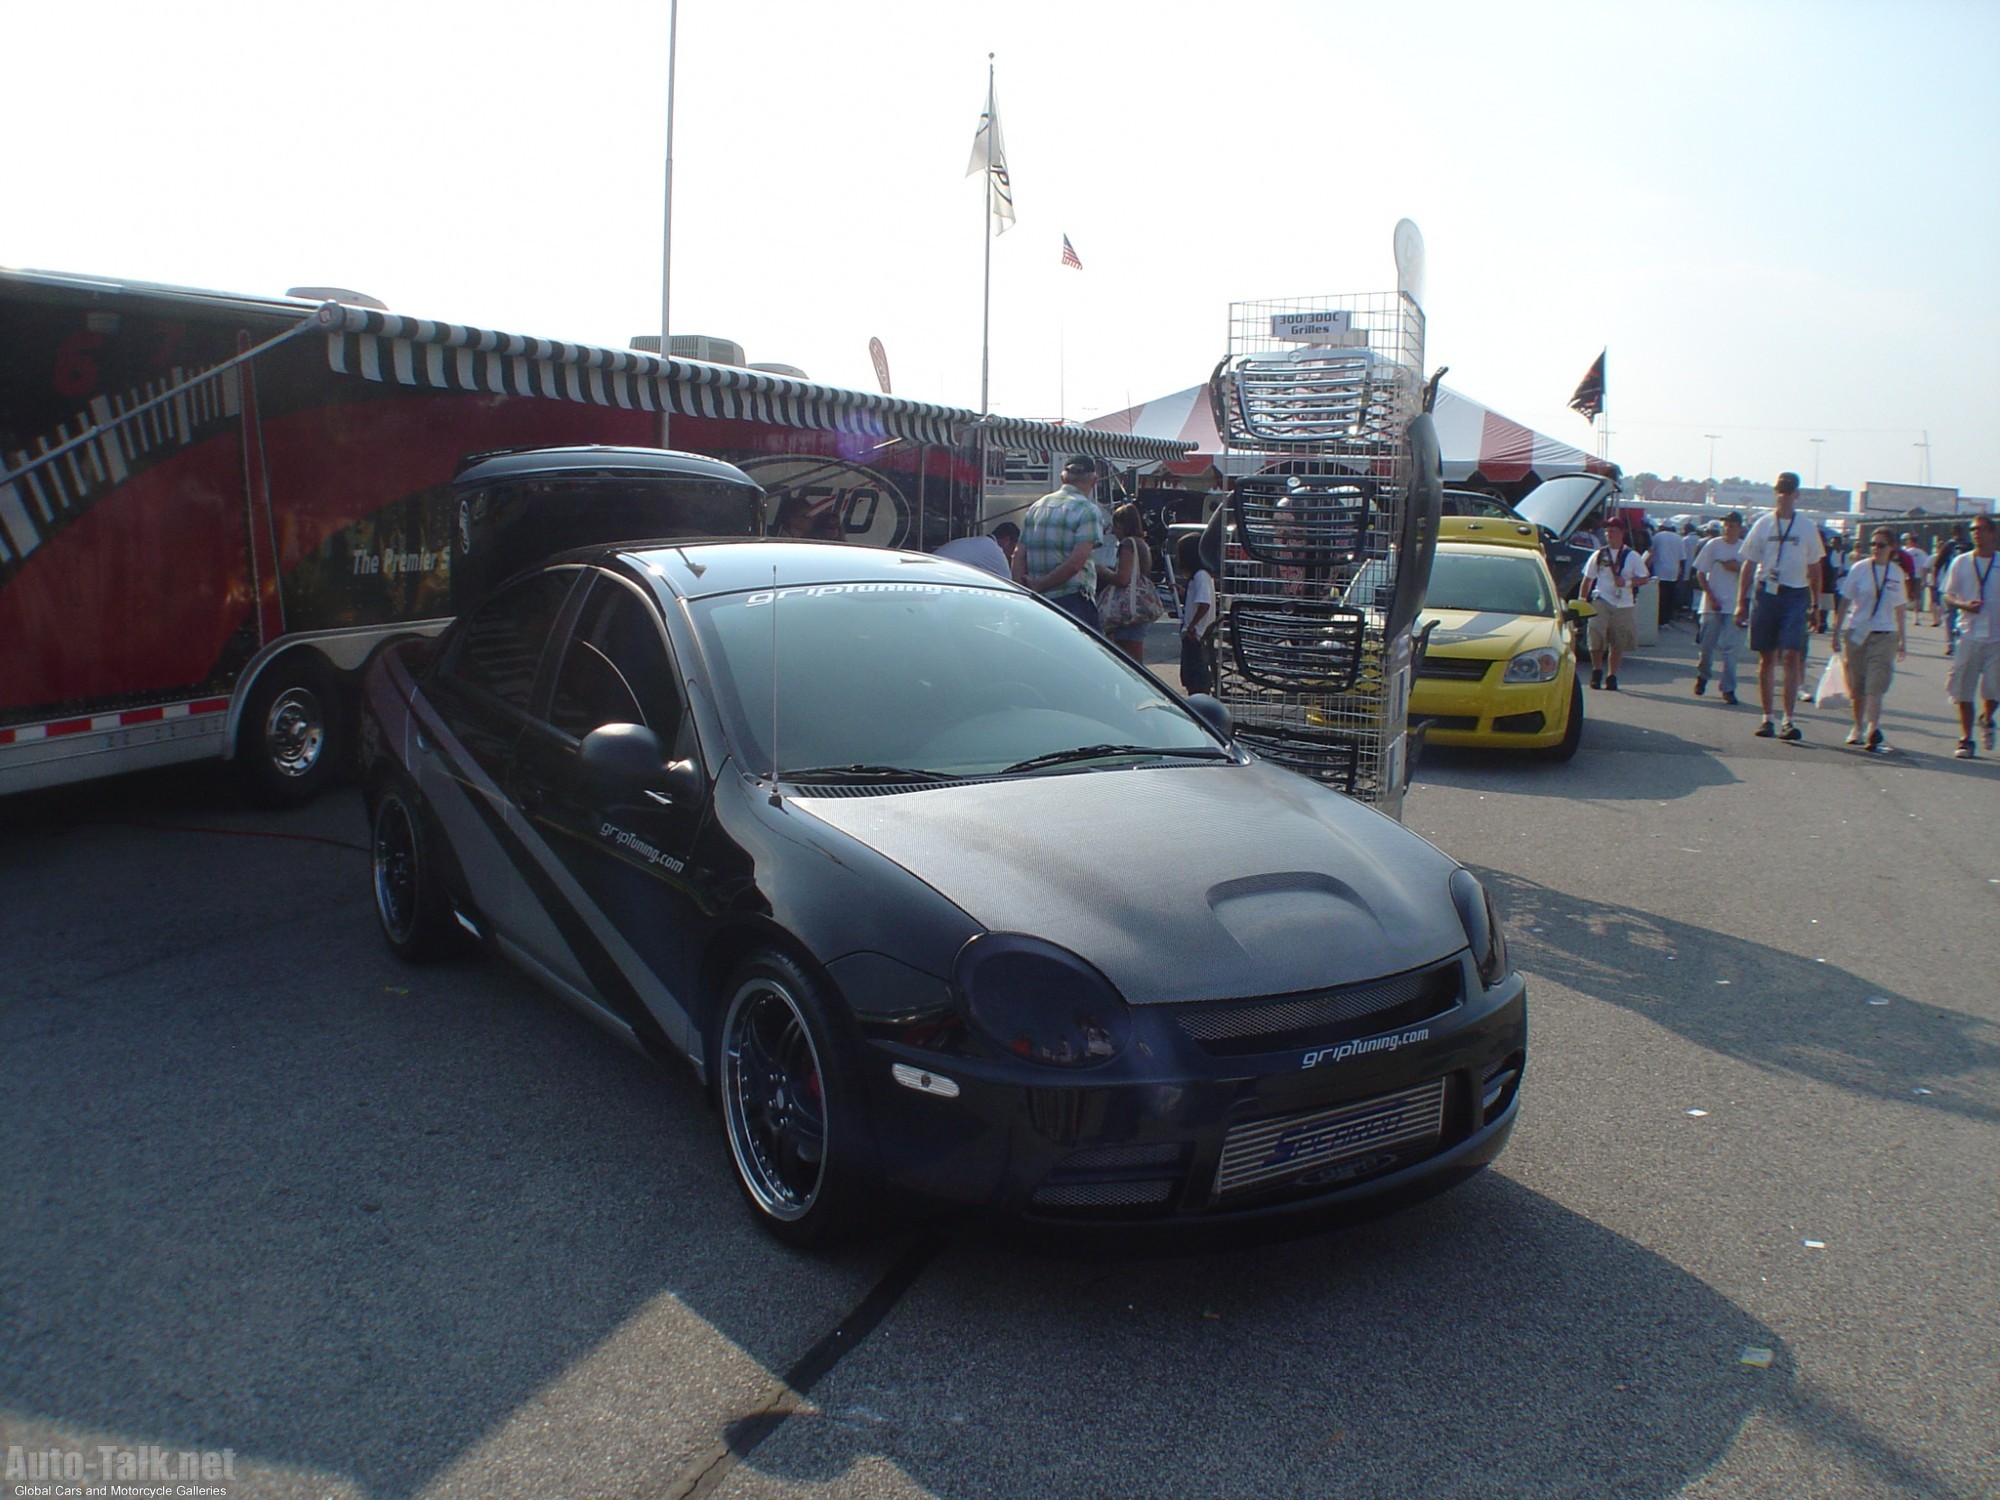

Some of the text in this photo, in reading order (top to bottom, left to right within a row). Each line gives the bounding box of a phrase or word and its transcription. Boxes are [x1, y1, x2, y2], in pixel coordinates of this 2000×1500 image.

[1279, 312, 1340, 325] 300/300C
[1291, 325, 1330, 336] Grilles
[352, 548, 380, 575] The
[383, 546, 437, 573] Premier
